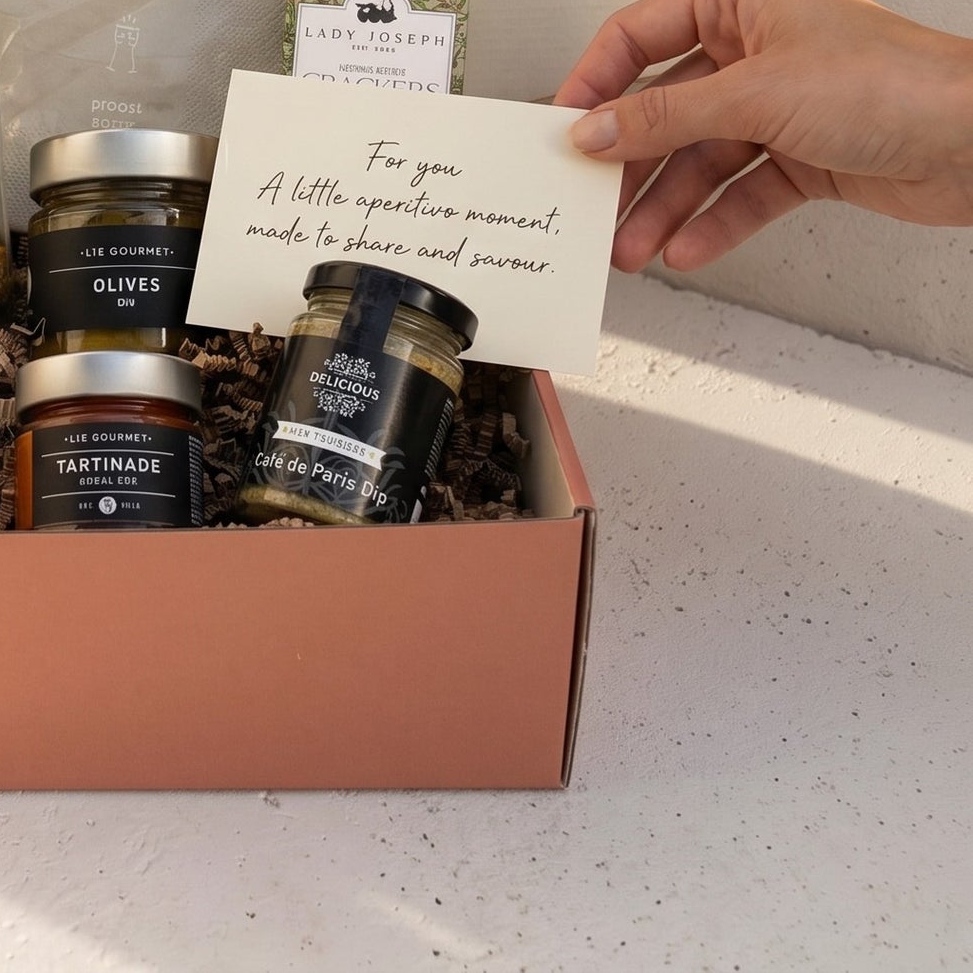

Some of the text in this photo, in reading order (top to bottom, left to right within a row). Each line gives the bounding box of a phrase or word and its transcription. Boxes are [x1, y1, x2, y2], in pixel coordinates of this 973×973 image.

[304, 26, 446, 47] LADY JOSEPH
[91, 99, 143, 115] proost
[366, 139, 464, 188] For you
[256, 171, 562, 236] A little aperitivo moment,
[109, 246, 170, 257] GOURMET
[245, 216, 557, 275] made to share and savour.
[93, 277, 161, 293] OLIVES
[309, 370, 381, 402] DELICIOUS
[91, 432, 148, 443] GOURMET
[56, 456, 162, 474] TARTINADE
[254, 451, 388, 508] Café de Paris Dip
